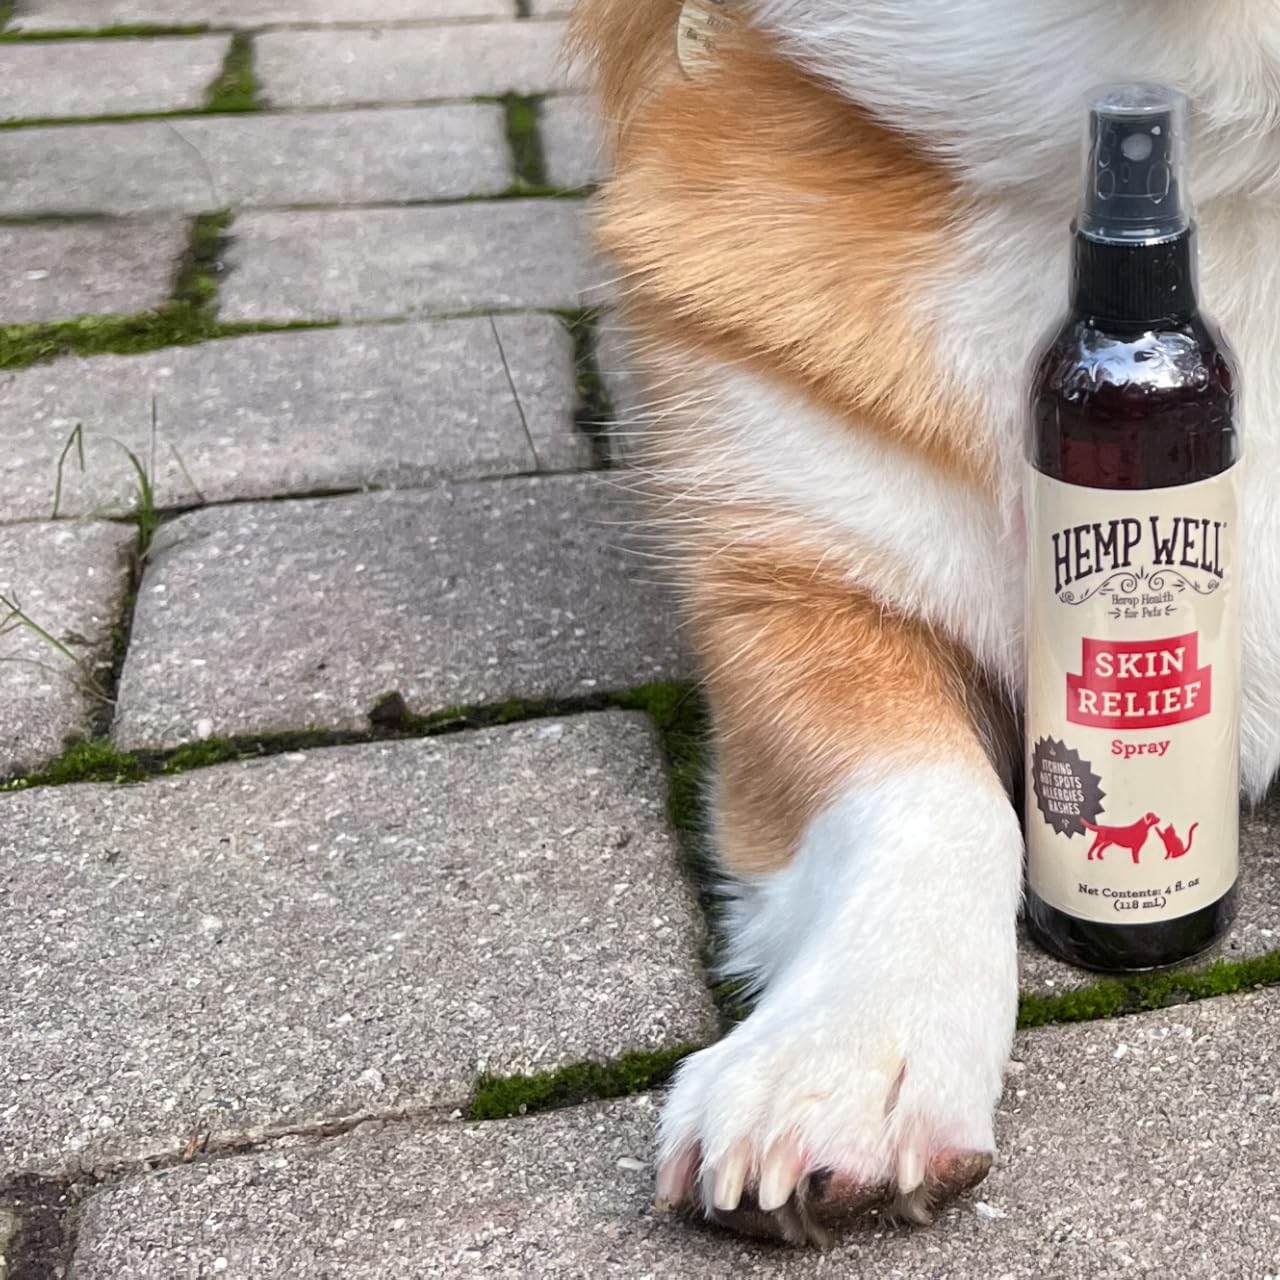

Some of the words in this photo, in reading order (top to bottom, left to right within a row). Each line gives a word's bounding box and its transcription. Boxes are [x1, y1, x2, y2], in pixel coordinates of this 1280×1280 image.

[1052, 518, 1142, 595] HEMP
[1149, 515, 1223, 579] WELL
[1112, 594, 1140, 608] Hemp
[1141, 592, 1174, 605] Health
[1124, 608, 1138, 619] for
[1142, 607, 1162, 618] Pets
[1095, 647, 1186, 678] SKIN
[1078, 681, 1201, 717] RELIEF
[1111, 739, 1170, 759] Spray
[1041, 759, 1072, 775] ITCHING
[1053, 776, 1082, 789] SPOTS
[1042, 786, 1085, 802] ALLERGIES
[1048, 800, 1081, 815] RASHES
[1078, 883, 1098, 896] Net
[1102, 888, 1161, 898] Contents:
[1164, 887, 1172, 896] 4
[1174, 880, 1186, 892] fl.
[1188, 877, 1200, 888] oz
[1113, 899, 1139, 911] (118
